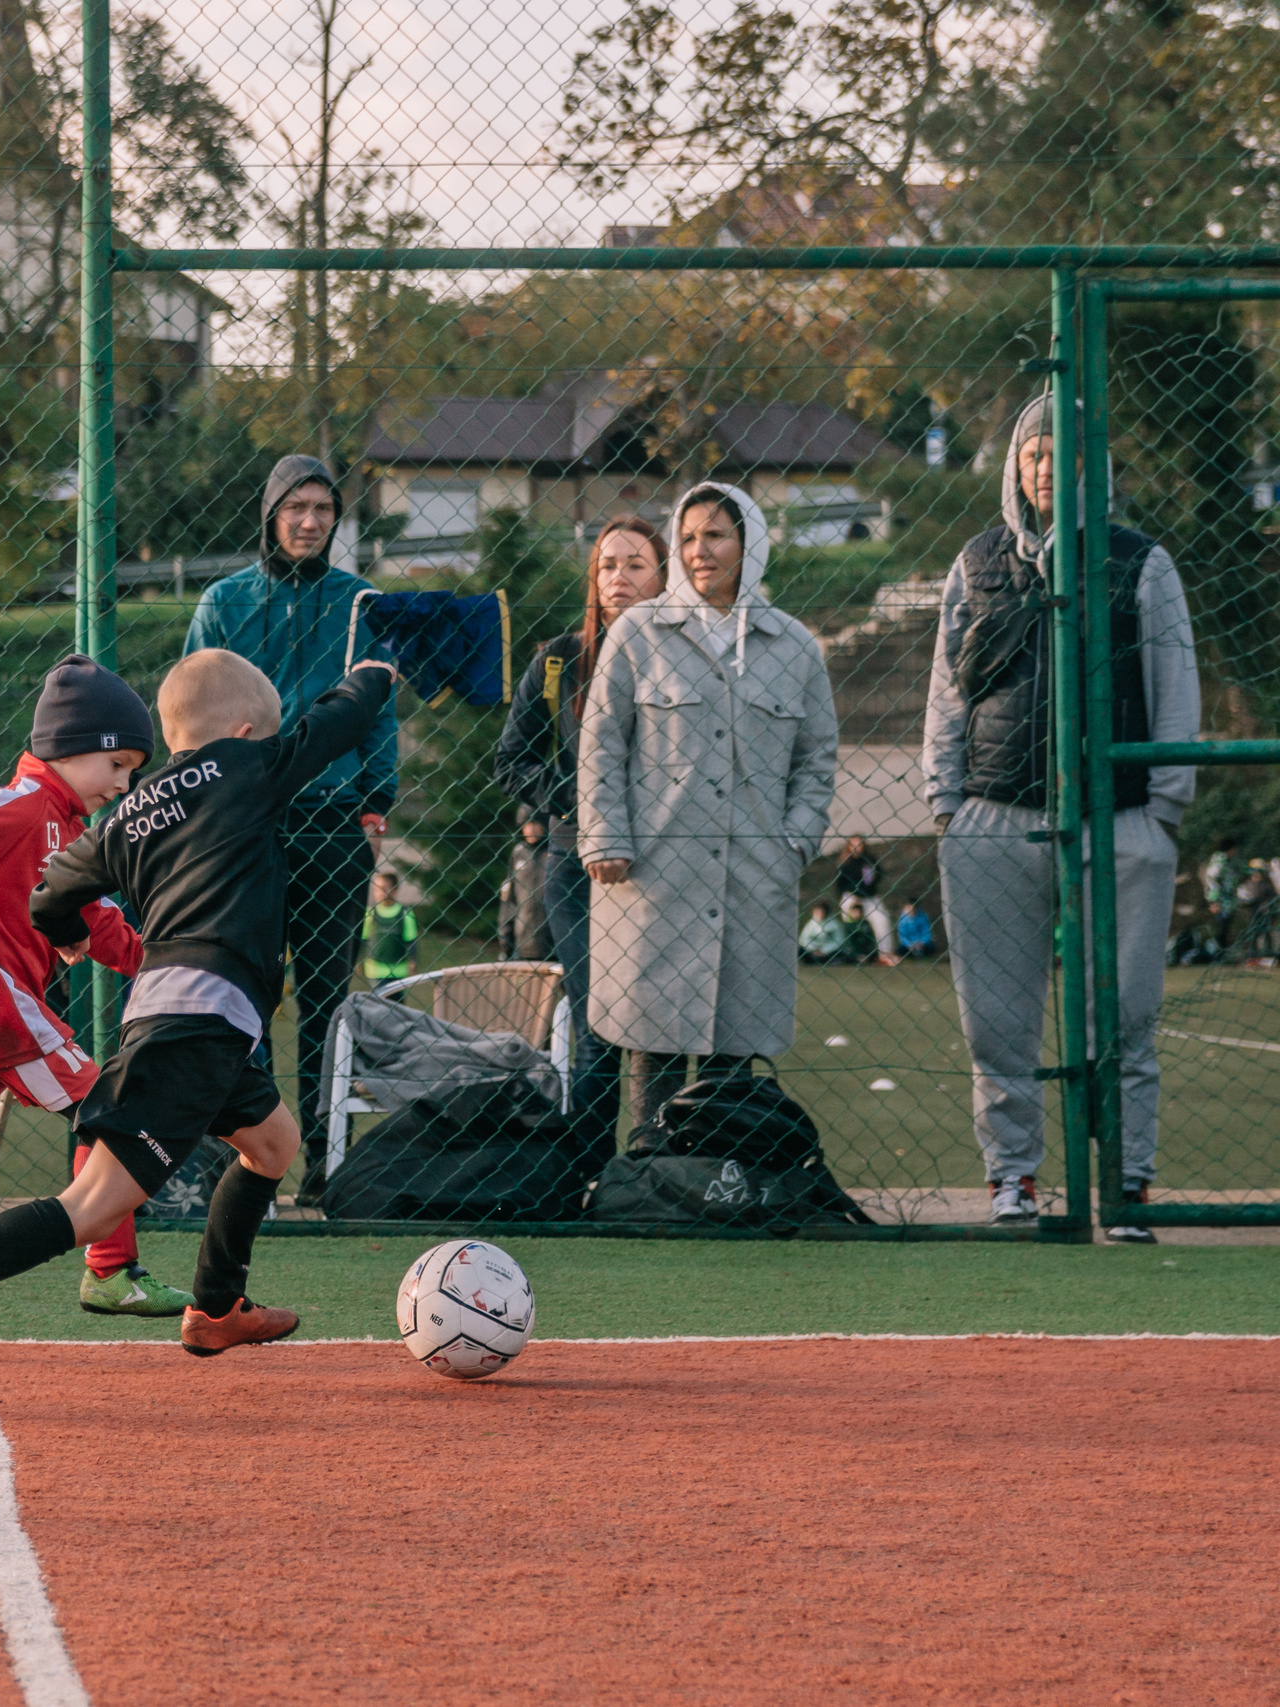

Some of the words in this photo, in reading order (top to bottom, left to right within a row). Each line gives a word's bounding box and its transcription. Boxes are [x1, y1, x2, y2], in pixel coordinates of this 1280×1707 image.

[46, 821, 60, 850] 13
[125, 801, 187, 843] SOCHI
[138, 1129, 173, 1167] PATRICK
[429, 1312, 444, 1327] NEO
